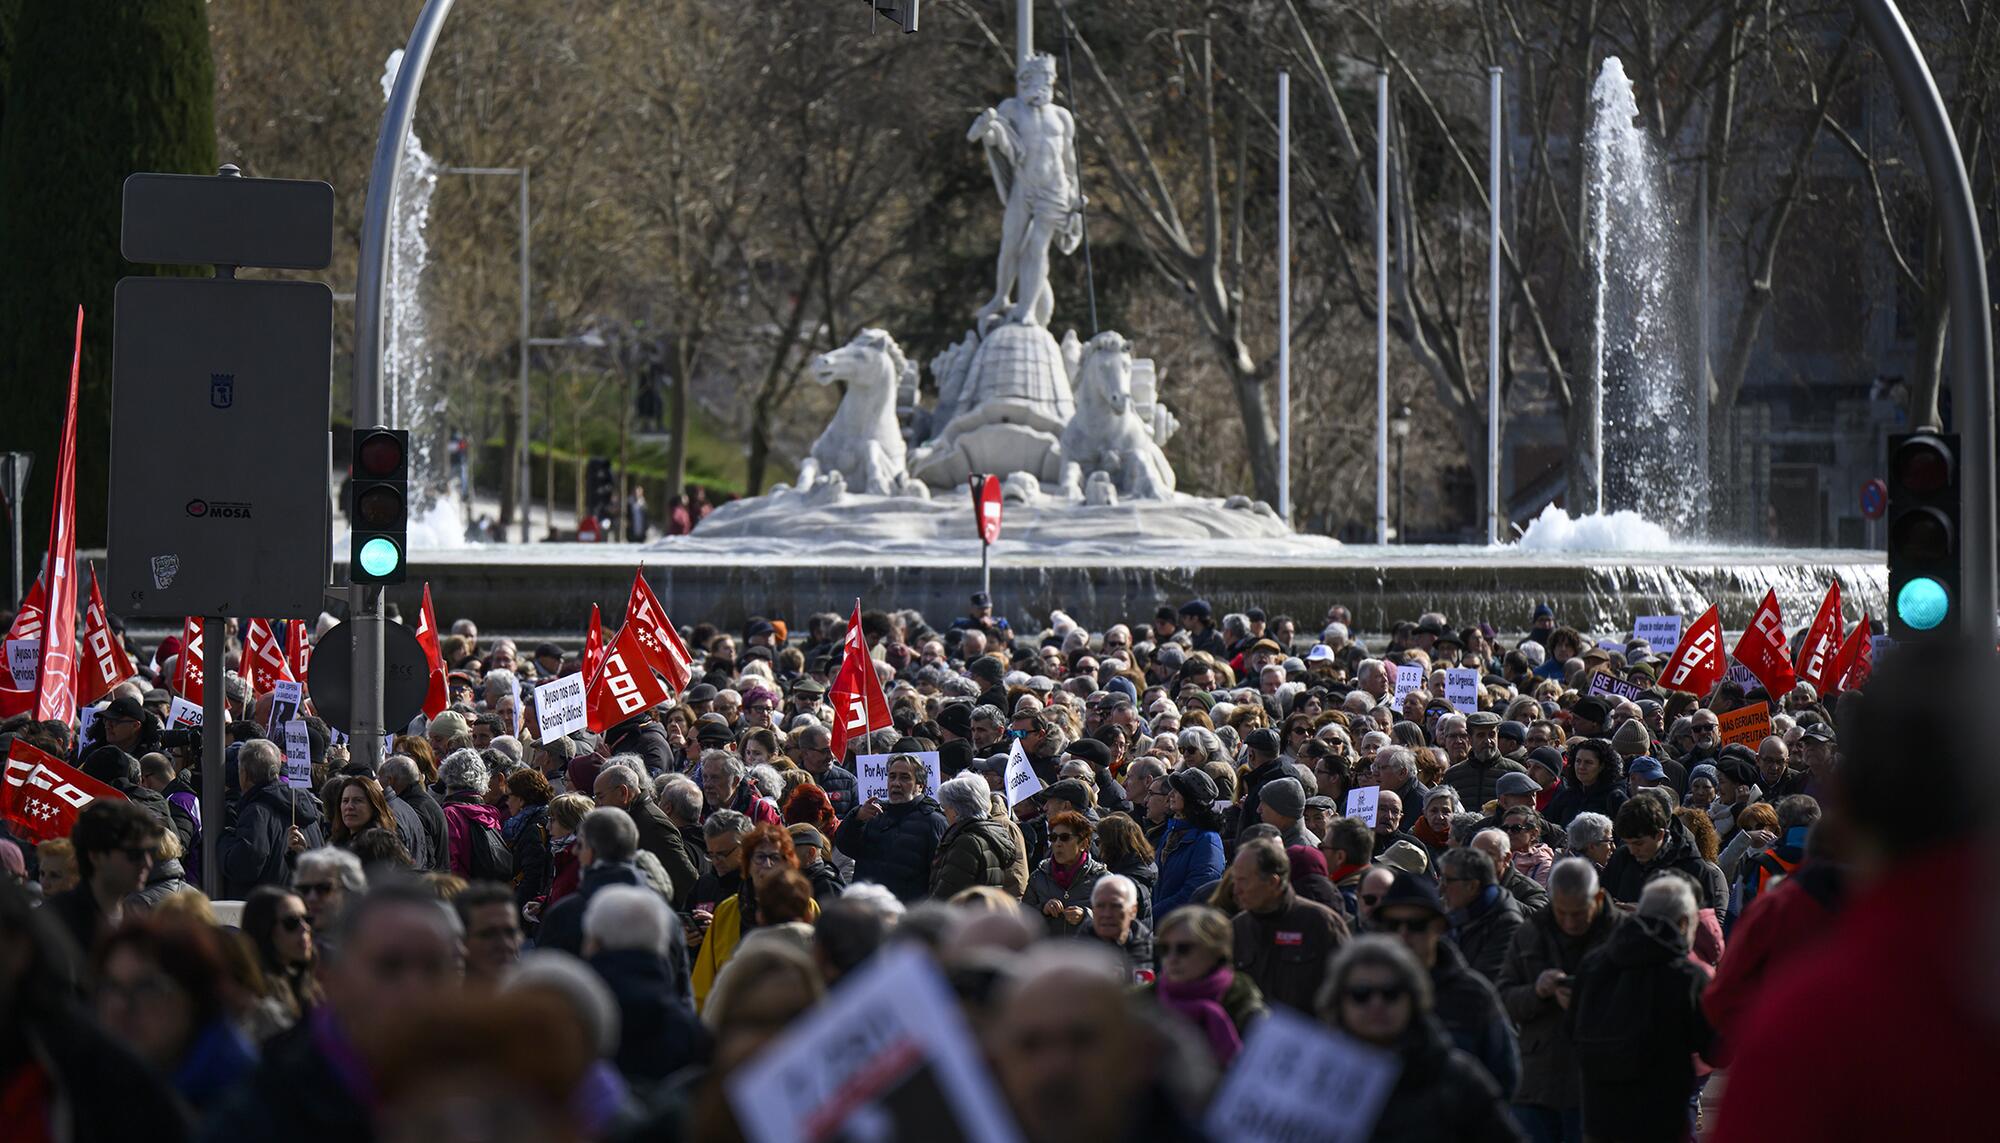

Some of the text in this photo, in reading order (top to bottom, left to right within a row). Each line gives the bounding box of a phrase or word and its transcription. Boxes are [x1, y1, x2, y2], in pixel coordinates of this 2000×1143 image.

[210, 508, 251, 519] MOSA
[559, 685, 569, 700] nos
[568, 680, 580, 696] roba
[1594, 673, 1612, 690] SE
[181, 707, 203, 725] 7.29
[542, 710, 563, 731] Servicios
[864, 763, 889, 780] Por Ayu
